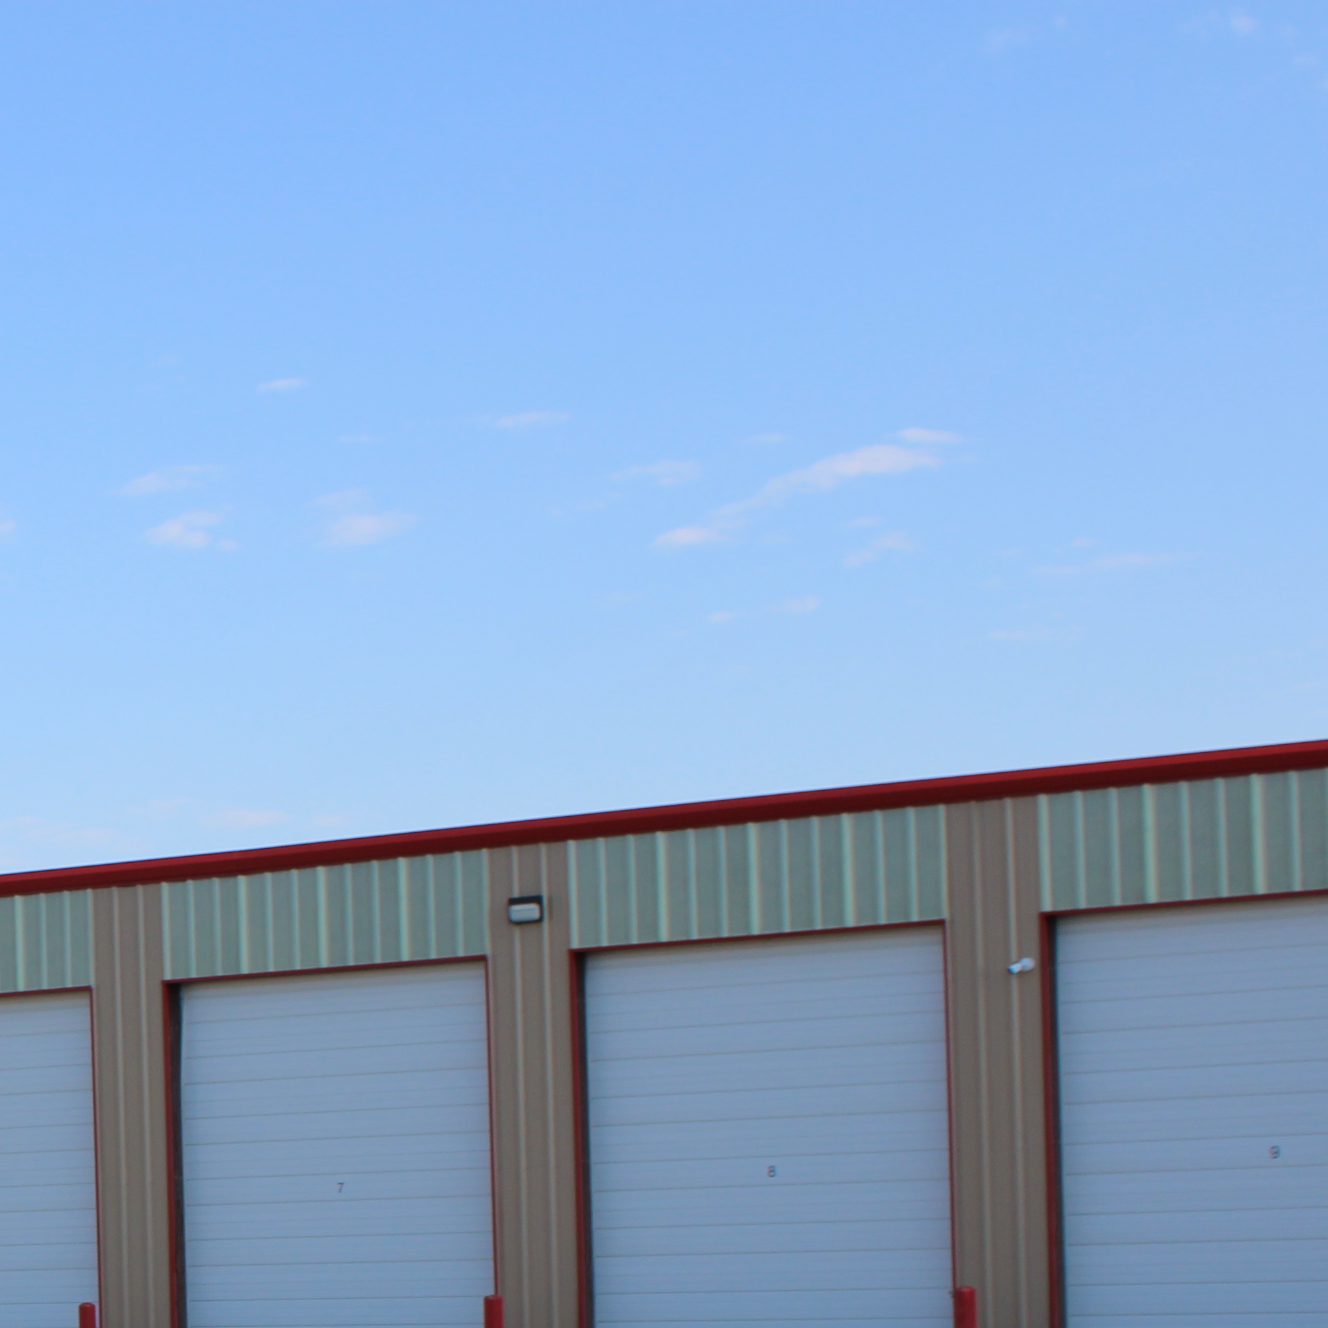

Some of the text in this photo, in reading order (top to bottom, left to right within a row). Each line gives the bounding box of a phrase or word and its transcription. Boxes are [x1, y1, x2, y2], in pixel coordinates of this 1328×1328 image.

[1268, 1145, 1280, 1160] 9
[766, 1165, 777, 1178] 8
[336, 1182, 345, 1194] 7
